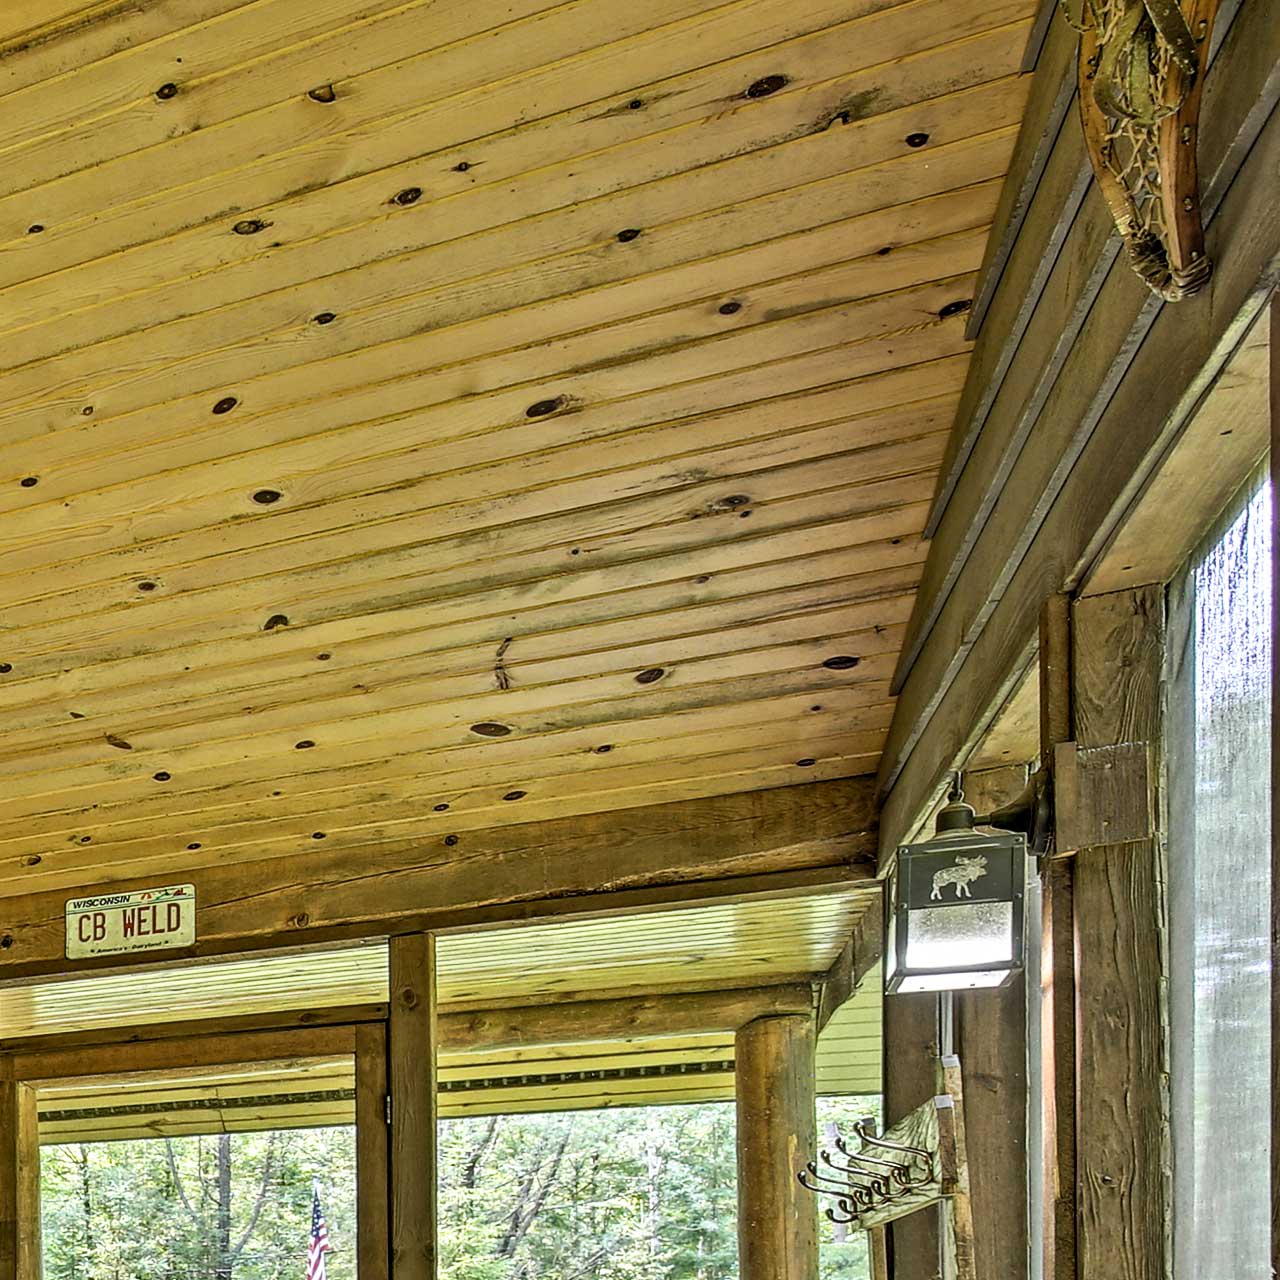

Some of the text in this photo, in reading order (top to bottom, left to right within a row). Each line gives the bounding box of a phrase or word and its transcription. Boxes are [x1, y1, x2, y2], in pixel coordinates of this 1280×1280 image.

[73, 895, 131, 909] WISCONSIN
[79, 902, 181, 943] CB WELD
